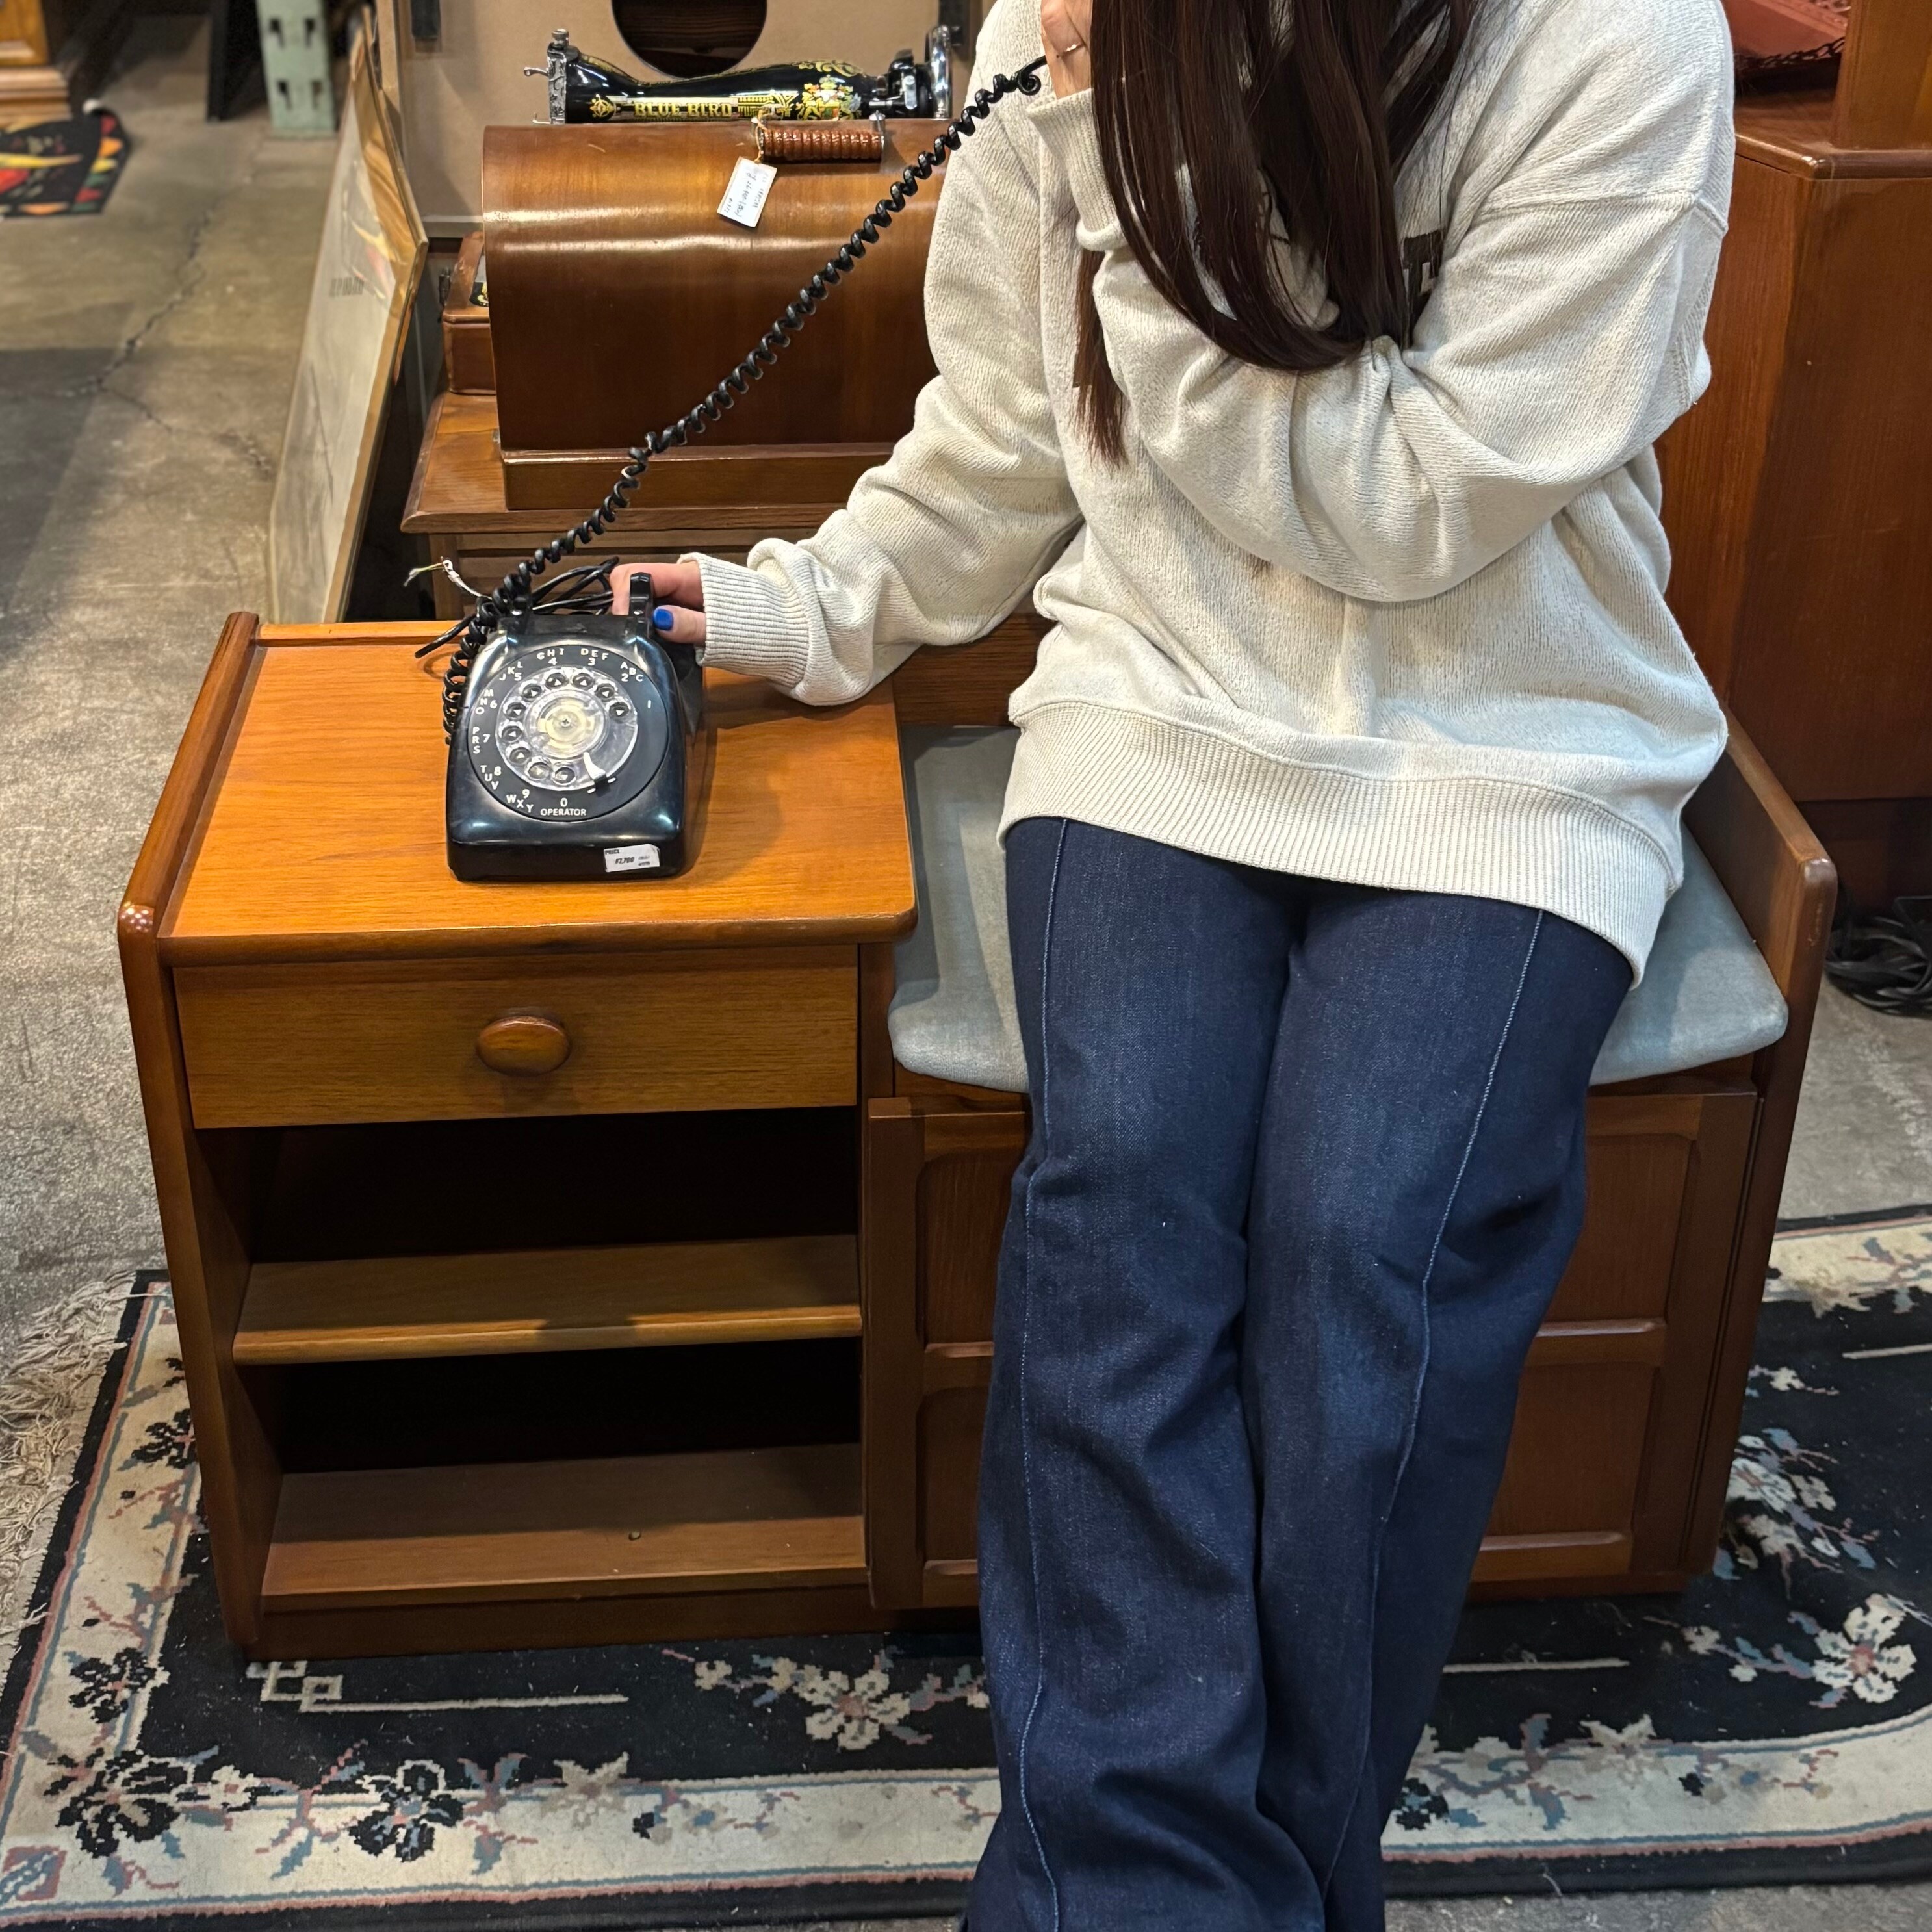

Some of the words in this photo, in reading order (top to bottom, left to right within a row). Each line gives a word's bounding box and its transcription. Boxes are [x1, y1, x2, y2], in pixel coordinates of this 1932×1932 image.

[634, 102, 682, 116] BLUE
[686, 103, 732, 117] BIRD
[548, 657, 558, 665] 4
[587, 657, 596, 666] 3
[514, 672, 522, 681] 5
[621, 673, 629, 682] 2
[489, 699, 498, 709] 6
[483, 734, 491, 743] 7
[494, 766, 502, 776] 8
[522, 788, 530, 799] 9
[560, 797, 568, 807] 0
[540, 808, 587, 816] OPERATOR
